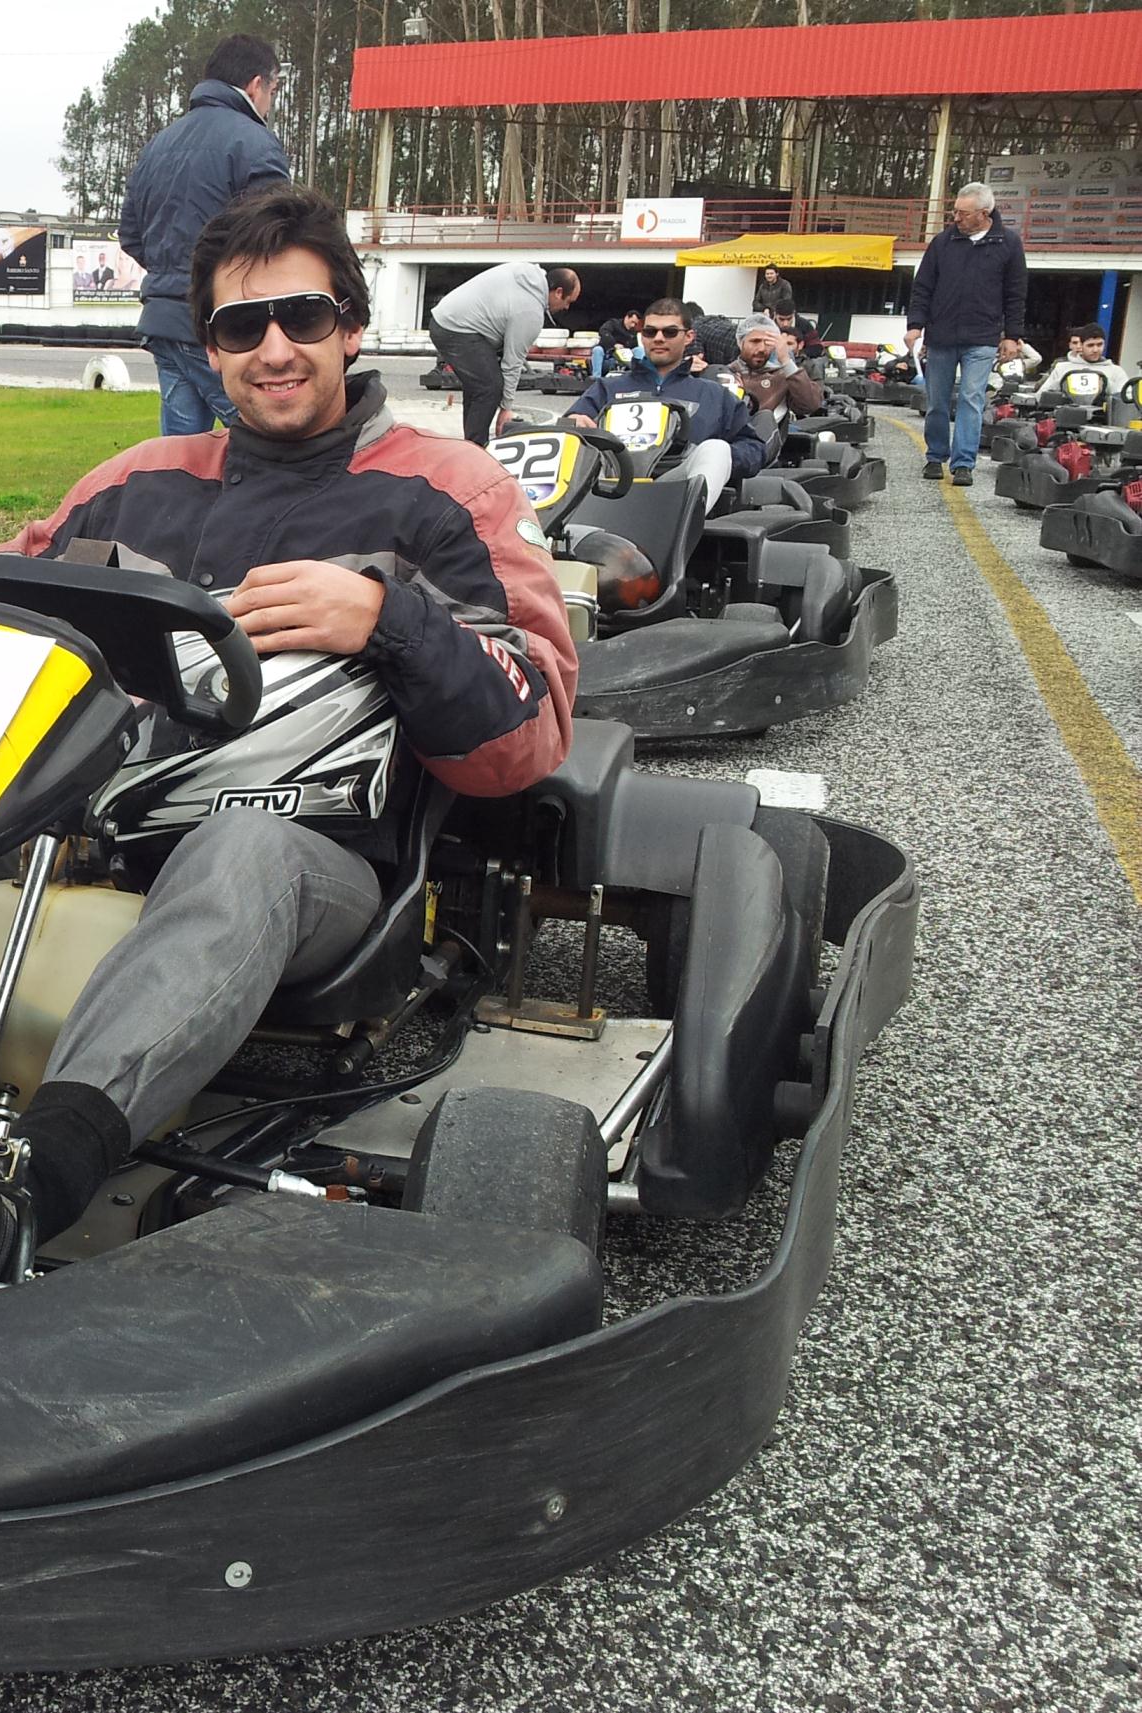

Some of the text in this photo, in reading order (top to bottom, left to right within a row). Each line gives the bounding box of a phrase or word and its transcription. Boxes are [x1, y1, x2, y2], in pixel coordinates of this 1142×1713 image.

[1080, 375, 1089, 386] 5
[627, 404, 643, 432] 3
[495, 438, 560, 480] 22
